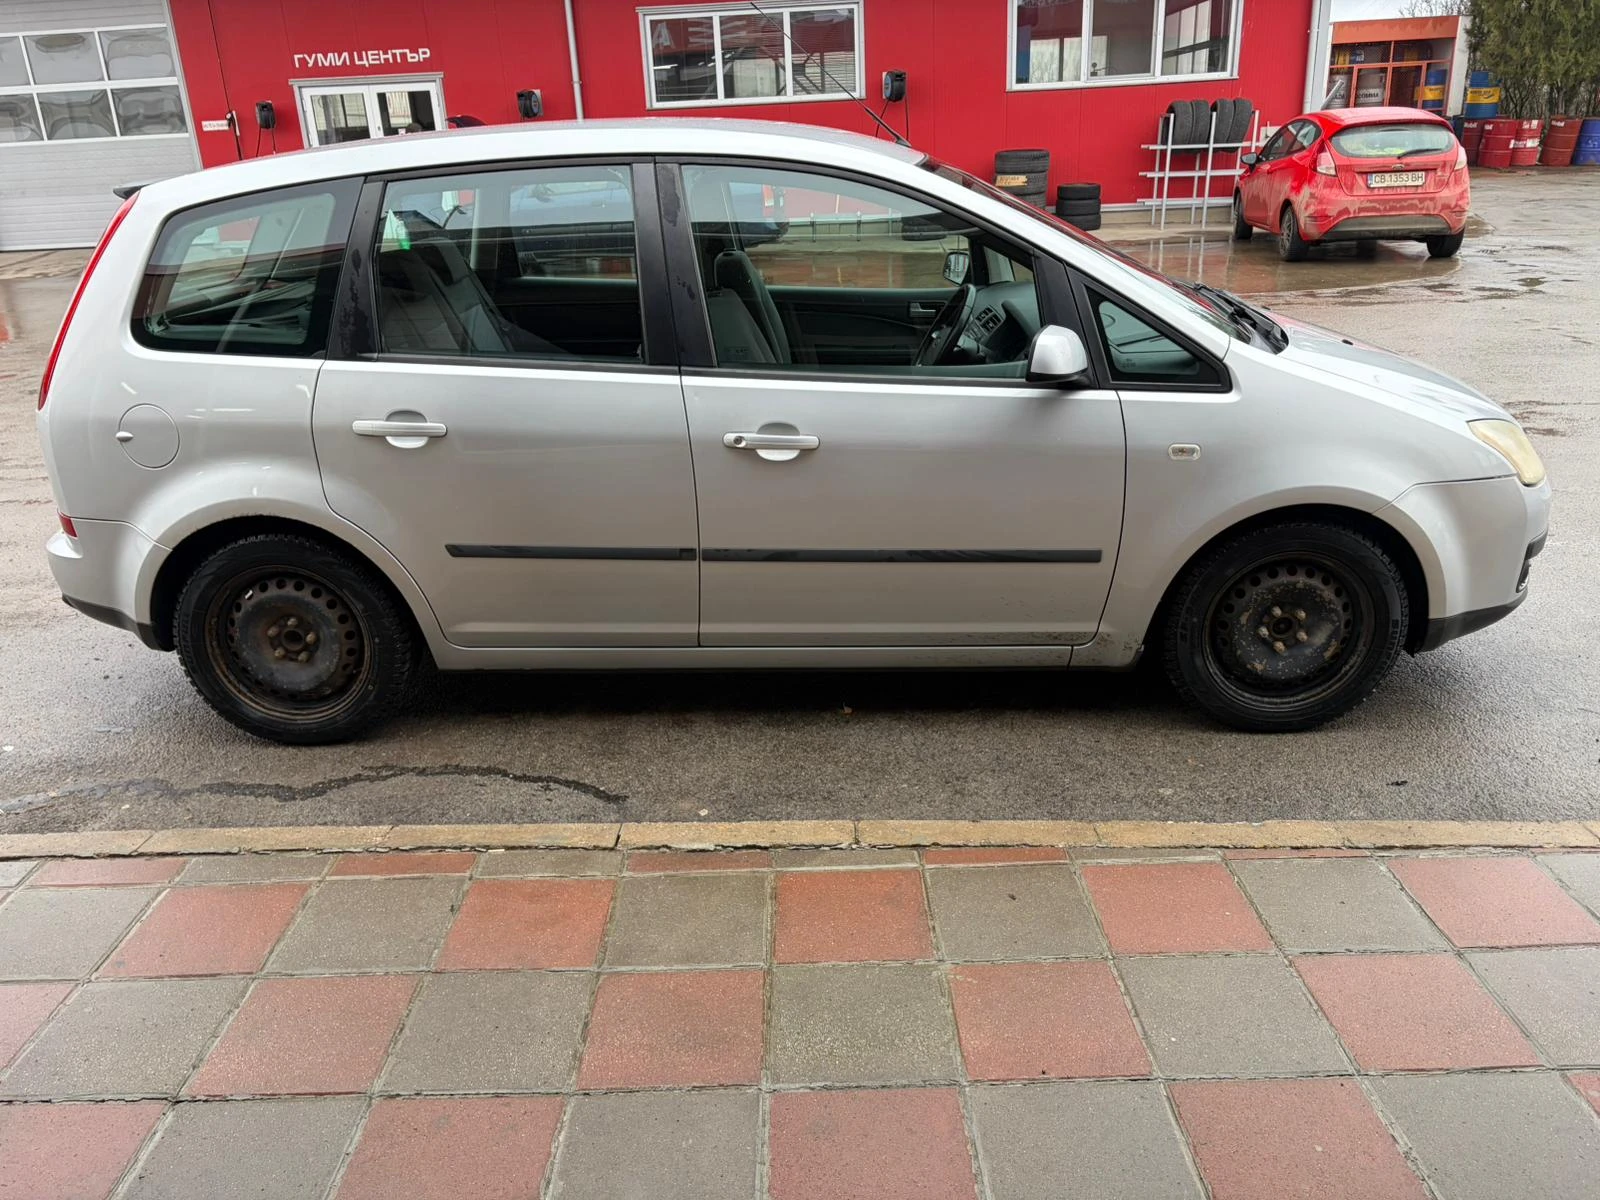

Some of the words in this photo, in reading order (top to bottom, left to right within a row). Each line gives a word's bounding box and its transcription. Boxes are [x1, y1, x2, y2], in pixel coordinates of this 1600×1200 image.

[294, 52, 350, 68] ГУМИ
[354, 48, 431, 67] ЦЕНТЪР
[1388, 173, 1410, 183] 1353
